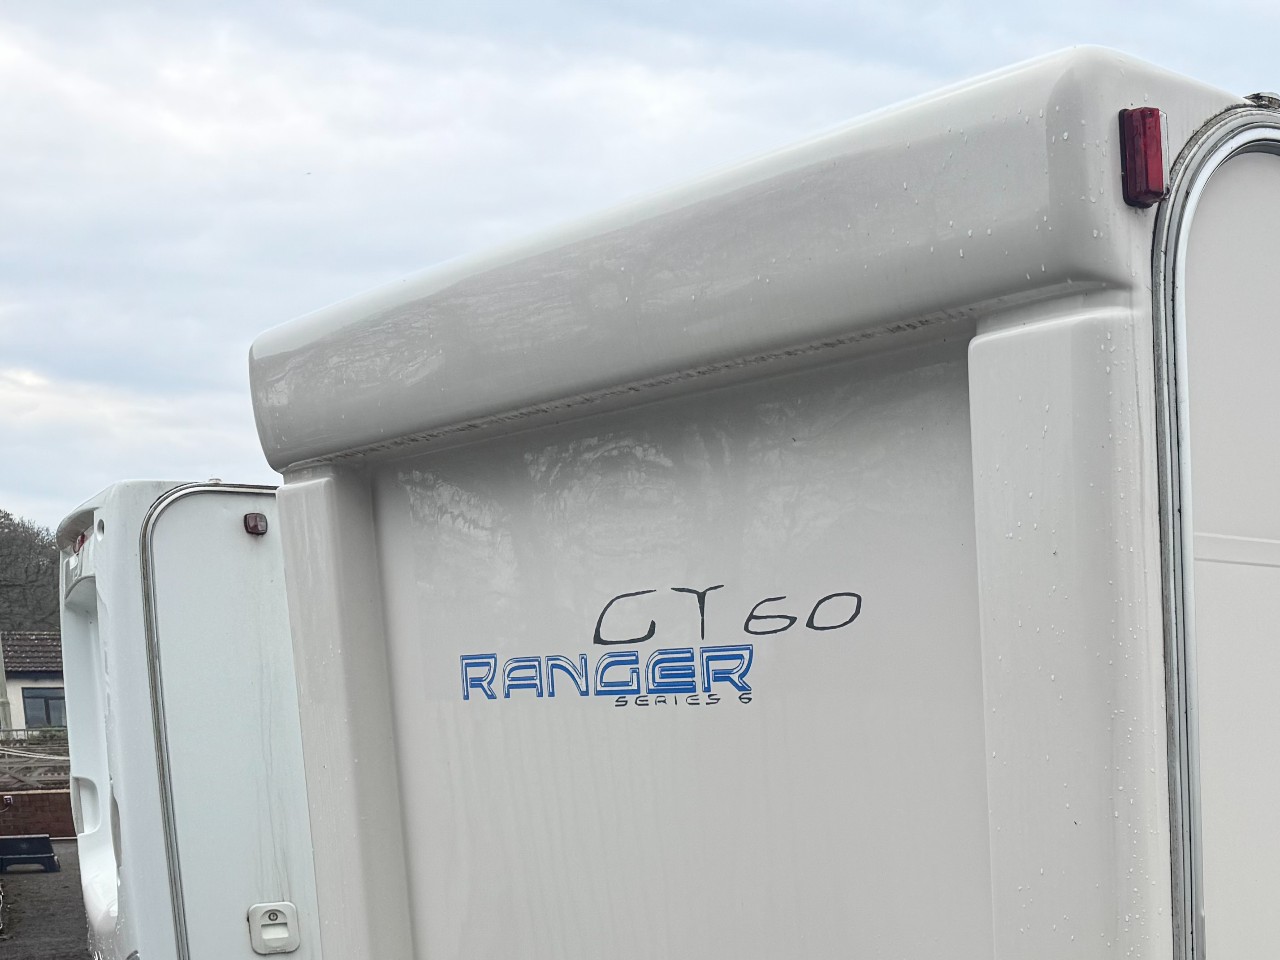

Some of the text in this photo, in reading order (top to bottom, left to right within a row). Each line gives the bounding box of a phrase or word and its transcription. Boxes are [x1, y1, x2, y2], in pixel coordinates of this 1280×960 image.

[460, 643, 754, 699] RANGER
[614, 692, 753, 707] SERIES 6
